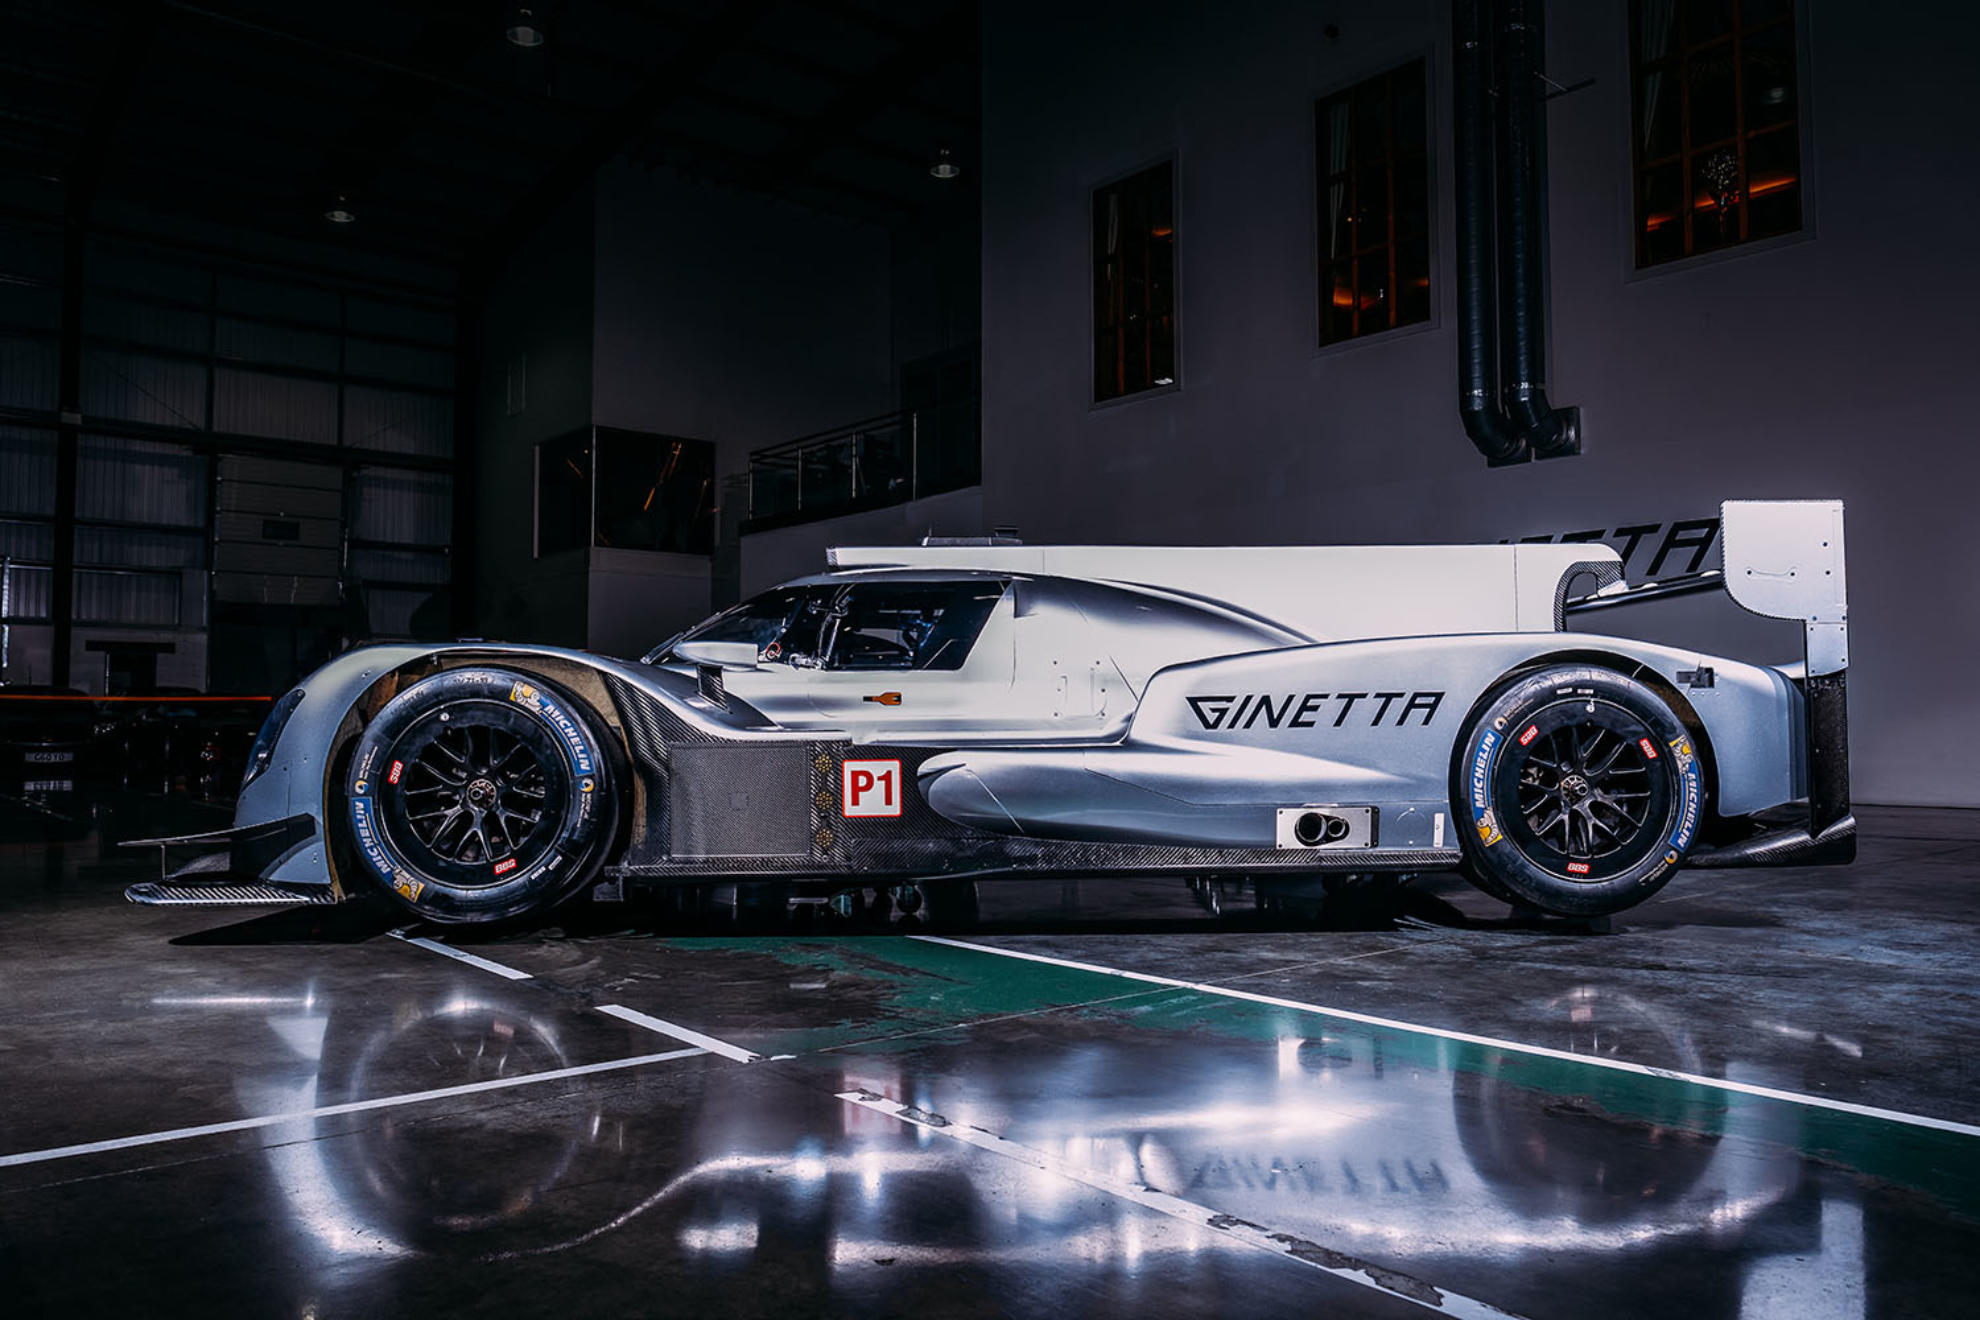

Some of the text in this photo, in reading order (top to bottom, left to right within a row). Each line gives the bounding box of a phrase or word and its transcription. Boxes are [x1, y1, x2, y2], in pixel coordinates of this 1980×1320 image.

[543, 703, 592, 772] MICHELIN
[1185, 691, 1446, 730] GINETTA
[850, 769, 893, 806] P1
[1474, 732, 1496, 809] MICHELIN
[354, 801, 391, 875] MICHELIN
[1677, 772, 1697, 848] MICHELIN
